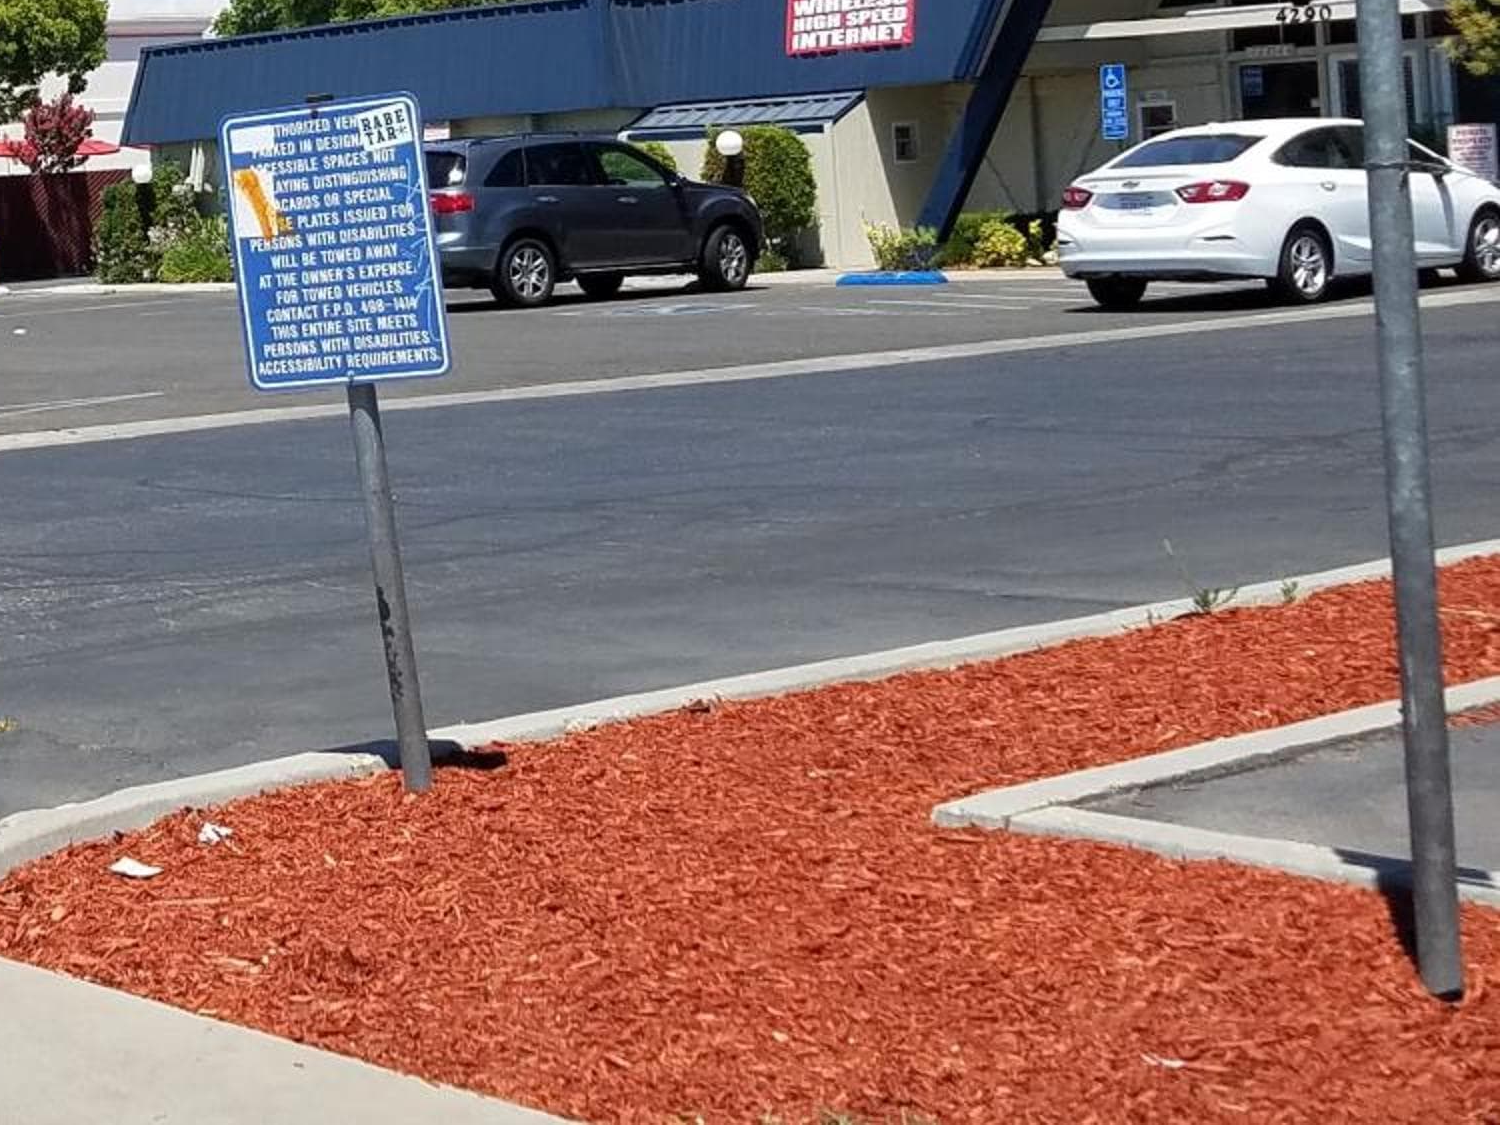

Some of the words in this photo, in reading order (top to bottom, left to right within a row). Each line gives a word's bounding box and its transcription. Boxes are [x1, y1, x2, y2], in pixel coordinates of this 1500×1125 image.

[793, 13, 842, 32] HIGH
[846, 6, 907, 27] SPEED
[1276, 5, 1332, 25] 4290
[792, 23, 906, 50] INTERNET
[274, 119, 330, 138] THORIZED
[300, 138, 312, 153] IN
[324, 152, 369, 170] SPACES
[373, 148, 396, 163] NOT
[314, 166, 406, 189] DISTINGUISHING
[324, 192, 339, 206] OR
[344, 187, 394, 204] SPECIAL
[298, 213, 340, 230] PLATES
[344, 208, 387, 224] ISSUED
[392, 204, 415, 218] FOR
[251, 235, 303, 252] PERSONS
[306, 231, 336, 246] WITH
[339, 222, 415, 242] DISABILITIES
[270, 254, 299, 270] WILL
[302, 251, 316, 265] BE
[320, 248, 361, 264] TOWED
[365, 244, 398, 258] AWAY
[259, 275, 272, 289] AT
[276, 272, 297, 287] THE
[301, 267, 355, 285] OWNER'S
[276, 290, 298, 304] FOR
[303, 287, 342, 302] TOWED
[346, 280, 403, 298] VEHICLES
[266, 305, 319, 323] CONTACT
[271, 325, 299, 340] THIS
[302, 321, 343, 337] ENTIRE
[347, 317, 373, 332] SITE
[377, 314, 418, 329] MEETS
[264, 340, 317, 357] PERSONS
[321, 336, 349, 352] WITH
[353, 330, 430, 349] DISABILITIES
[259, 355, 342, 375] ACCESSIBILITY
